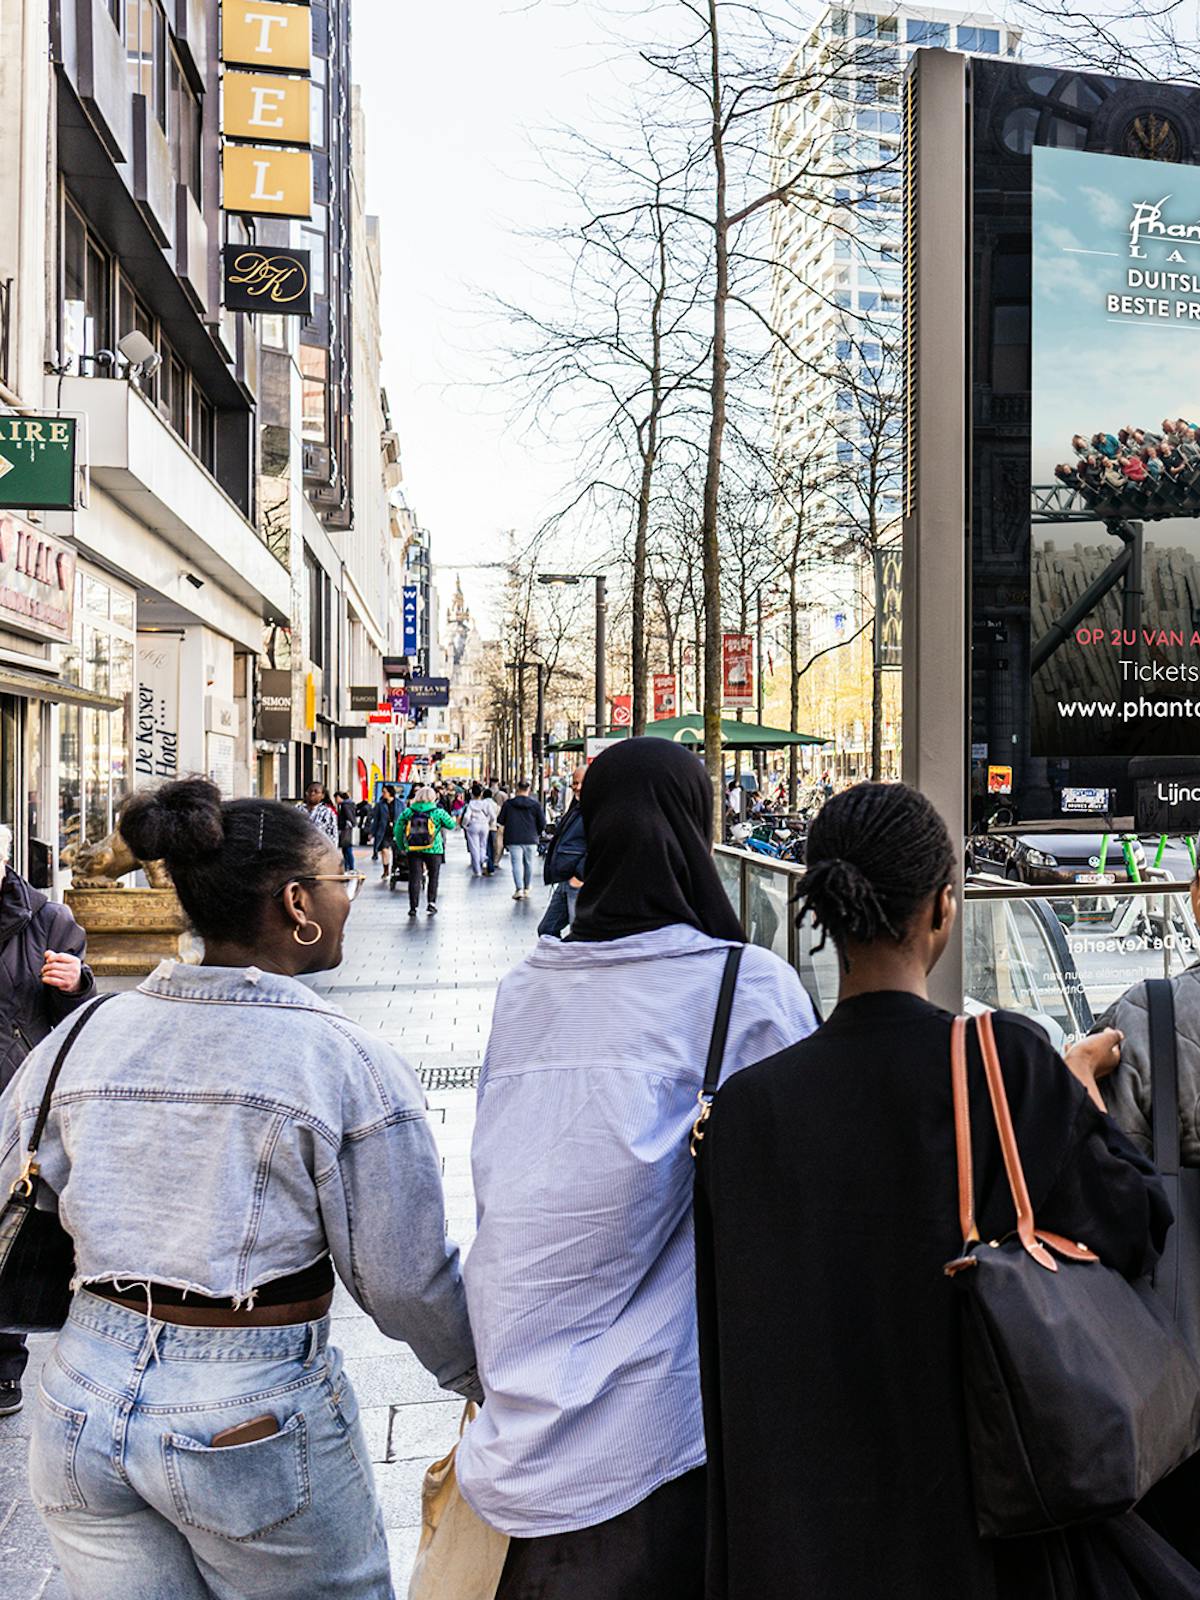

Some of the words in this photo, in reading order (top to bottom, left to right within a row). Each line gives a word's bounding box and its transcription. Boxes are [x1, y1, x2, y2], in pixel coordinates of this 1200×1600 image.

[1107, 295, 1169, 317] BESTE
[0, 420, 69, 443] IRE
[1076, 628, 1104, 646] OP
[1111, 629, 1137, 646] 2U
[1142, 630, 1184, 647] VAN
[1119, 660, 1199, 682] Tickets
[262, 697, 291, 706] SIMON
[136, 683, 158, 744] Keyser
[136, 748, 152, 775] De
[156, 729, 177, 779] Hotel
